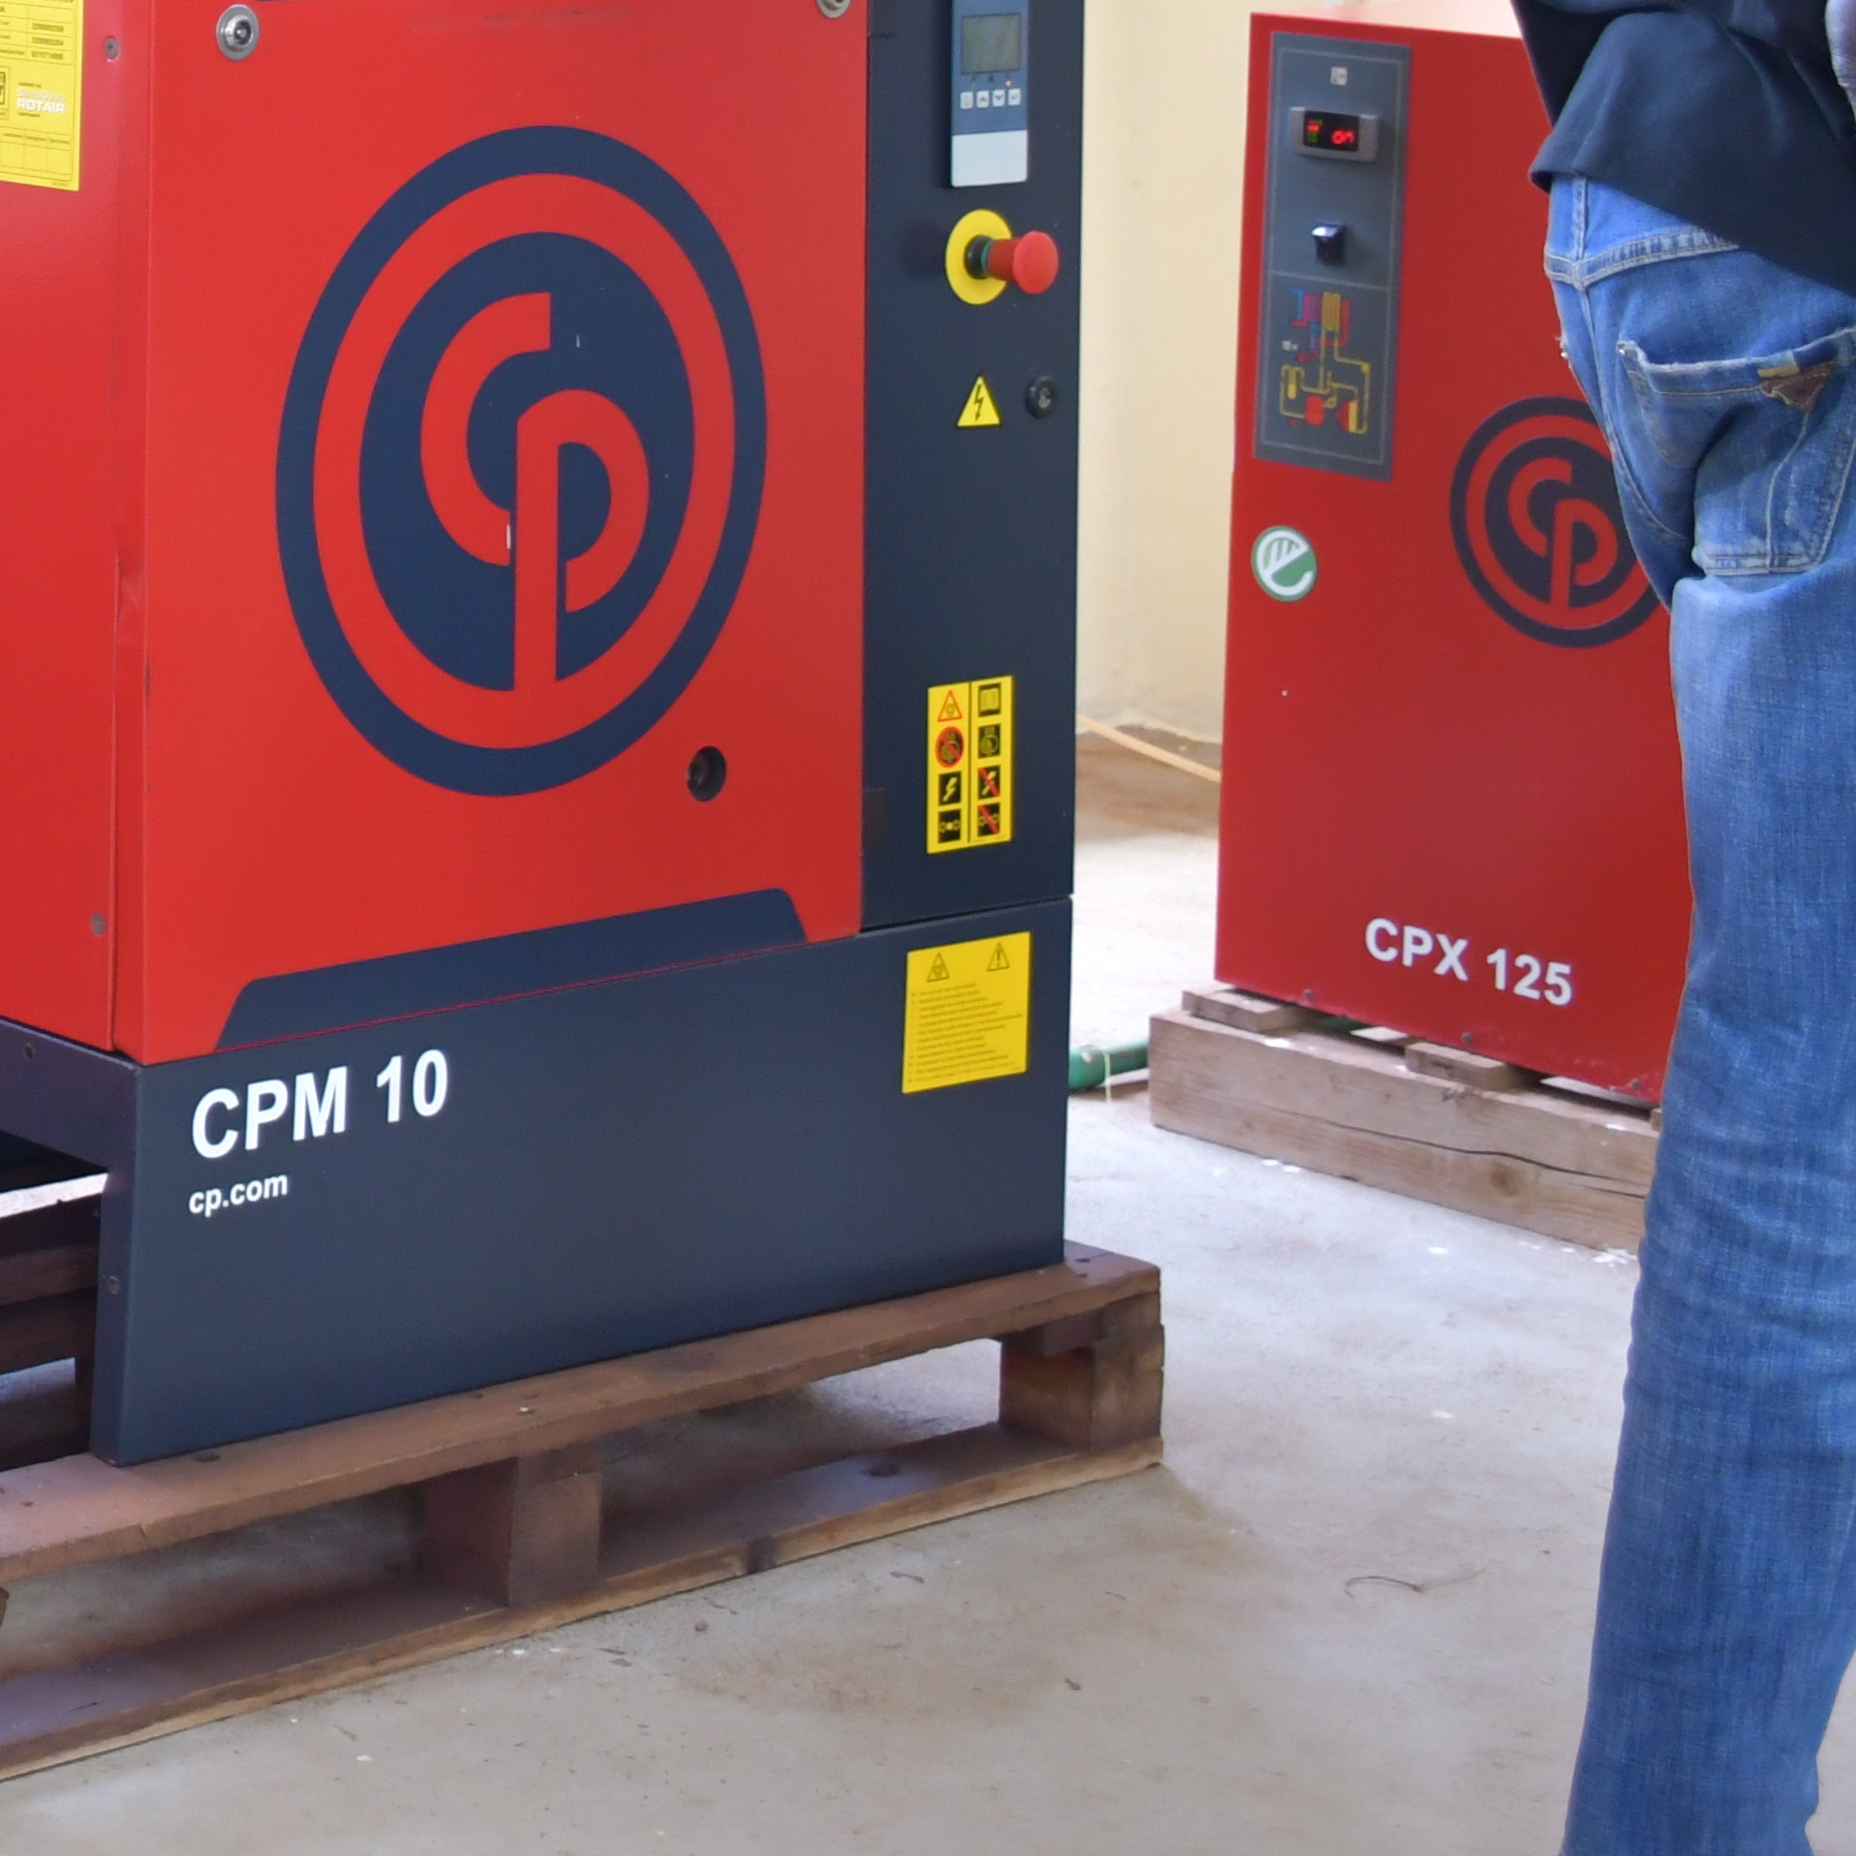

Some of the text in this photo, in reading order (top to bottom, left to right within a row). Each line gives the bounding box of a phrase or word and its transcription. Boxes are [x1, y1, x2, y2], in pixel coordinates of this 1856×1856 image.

[17, 98, 66, 114] ROTAIR
[1365, 918, 1574, 1006] CPX 125
[192, 1049, 448, 1159] CPM 10
[189, 1174, 288, 1218] cp.com
